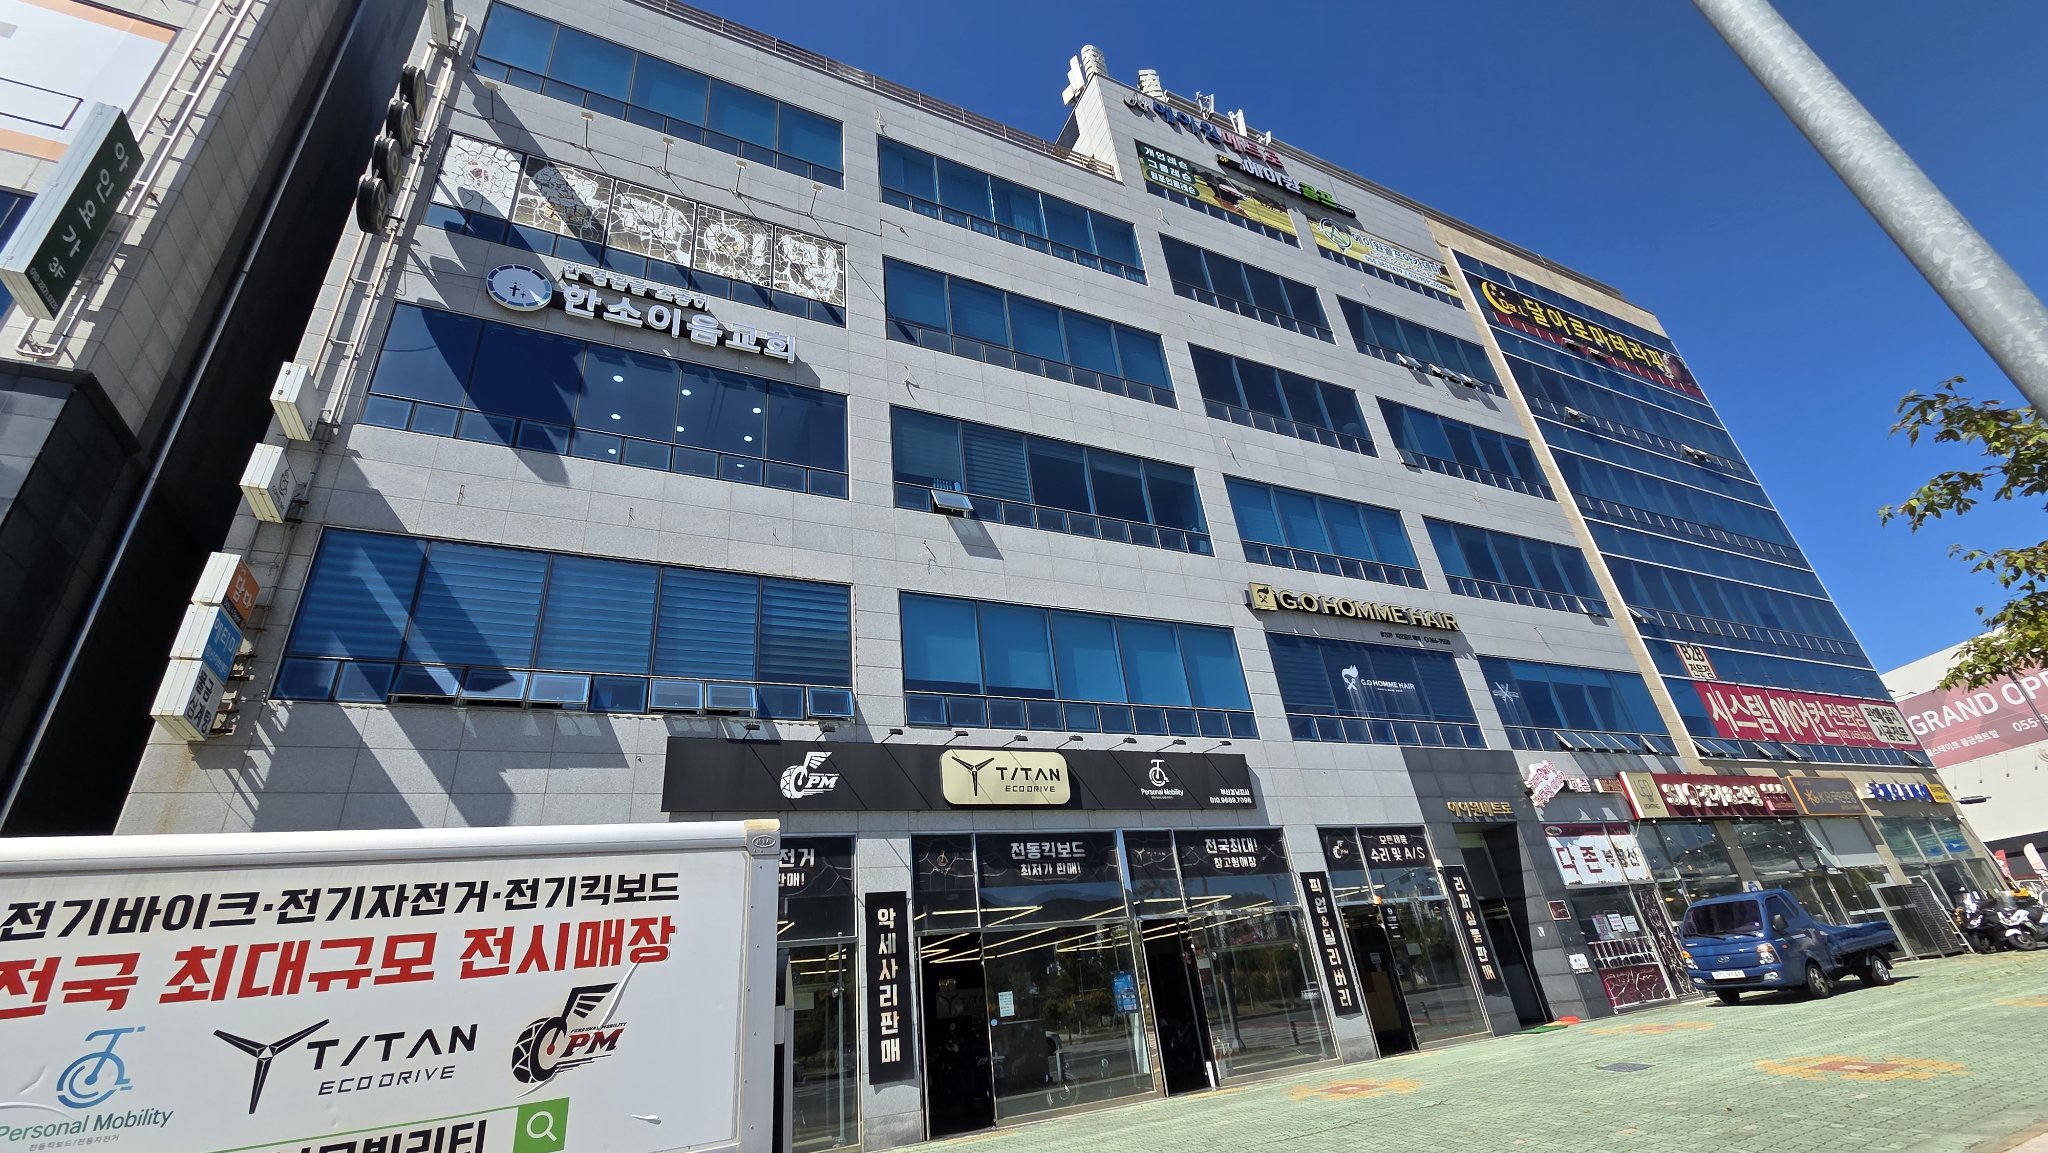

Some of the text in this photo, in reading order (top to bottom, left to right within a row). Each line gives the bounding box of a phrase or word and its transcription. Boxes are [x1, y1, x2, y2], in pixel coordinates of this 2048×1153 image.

[1153, 99, 1284, 168] 에이원메트로
[62, 141, 132, 260] 아인요가
[48, 255, 67, 281] 3F
[561, 282, 797, 365] 한소이음교회
[1523, 297, 1667, 374] 달아로마테라피
[1278, 589, 1461, 632] G.O HOMME HAIR
[1682, 643, 1706, 664] B2B
[197, 669, 215, 703] 물금
[1373, 680, 1398, 690] HOMME
[1398, 682, 1416, 692] HAIR
[1688, 662, 1716, 681] 전문점
[1706, 690, 1868, 739] 시스템 에어컨 전문점
[1907, 691, 2000, 737] GRAND
[995, 766, 1061, 783] TITAN
[1140, 788, 1184, 797] Personal Mobility
[1446, 801, 1515, 818] 에이원메트로
[1010, 841, 1088, 861] 전동킥보드
[1204, 837, 1259, 855] 전국최대!
[1371, 846, 1427, 863] 수리 및 A/S
[1020, 861, 1083, 877] 최저가 판매!
[1452, 876, 1497, 981] 리퍼상품판매
[0, 915, 678, 1020] 전국 최대규모 전시매장
[876, 907, 901, 1064] 악세사리판매
[306, 1023, 479, 1071] TITAN
[0, 1108, 174, 1143] Personal Mobility
